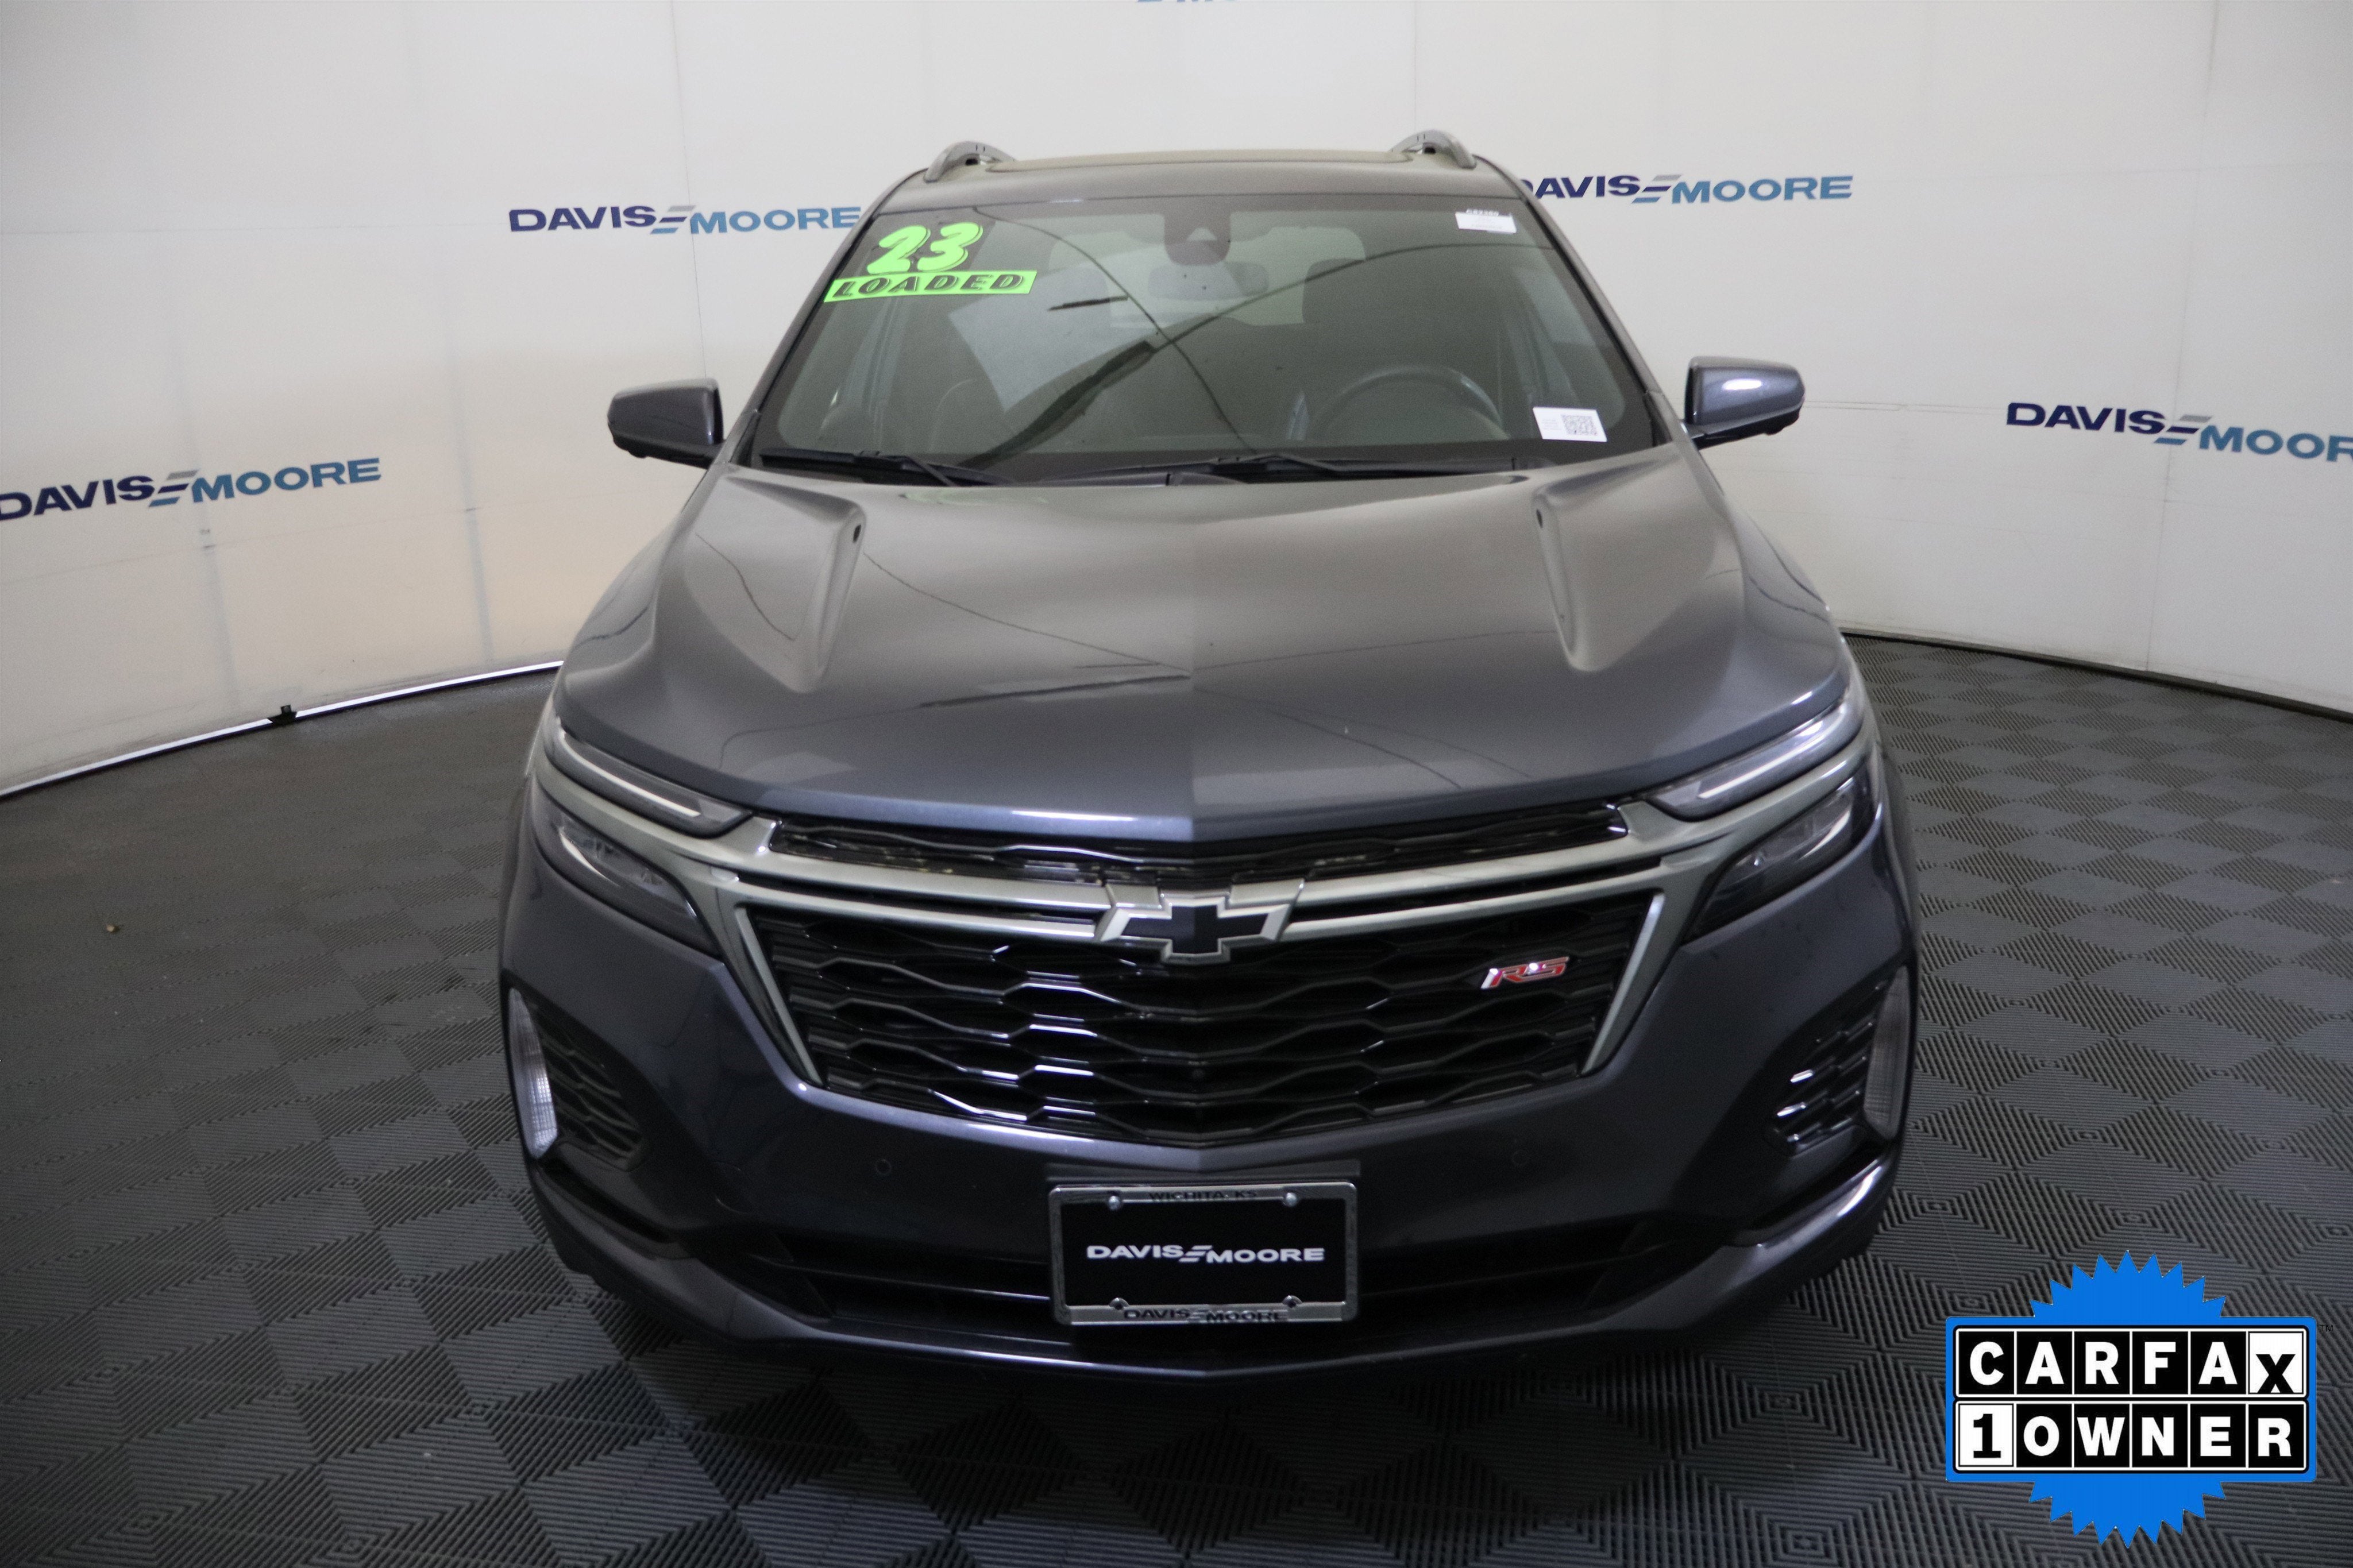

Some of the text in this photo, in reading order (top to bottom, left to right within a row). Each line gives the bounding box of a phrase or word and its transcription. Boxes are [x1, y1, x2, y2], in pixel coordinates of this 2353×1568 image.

[1672, 176, 1854, 204] MOORE
[509, 205, 861, 234] DAVIS MOORE
[867, 222, 983, 275] 23
[832, 273, 1024, 299] LOADED
[2006, 402, 2353, 462] DAVIS MOOR
[0, 457, 381, 521] DAVIS MOORE
[1480, 956, 1570, 990] RS
[1236, 1189, 1257, 1198] KS
[1086, 1245, 1325, 1264] DAVIS MOORE
[1124, 1308, 1288, 1322] DAVIS MOORE
